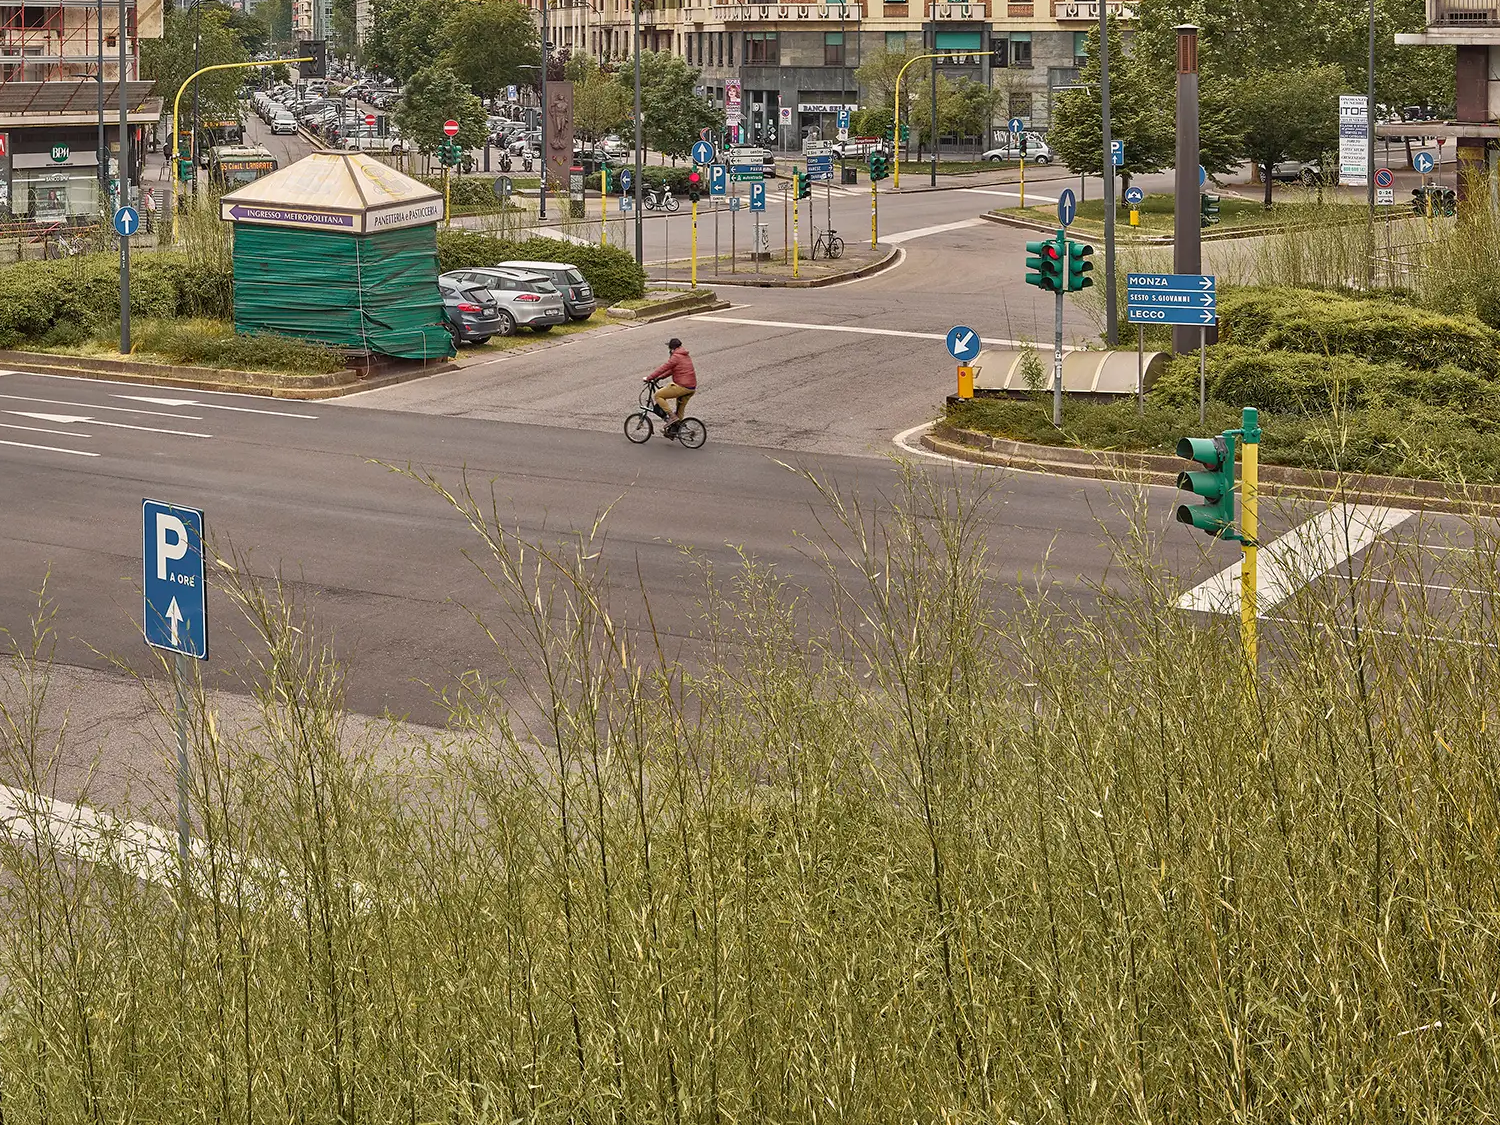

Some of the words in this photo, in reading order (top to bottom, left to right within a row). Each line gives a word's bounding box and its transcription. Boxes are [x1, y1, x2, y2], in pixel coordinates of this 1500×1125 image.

[840, 112, 847, 120] P
[52, 147, 69, 158] BPM
[1111, 142, 1120, 153] P
[713, 167, 723, 181] P
[754, 184, 762, 198] P
[247, 209, 281, 219] INGRESSO
[284, 213, 343, 224] METROPOLITANA
[374, 213, 404, 226] PANETTERIA
[409, 206, 438, 220] PASTICCERIA
[1130, 277, 1168, 286] MONZA
[1130, 310, 1165, 319] LECCO
[156, 512, 188, 580] P
[170, 572, 176, 582] A
[177, 575, 195, 587] ORE
